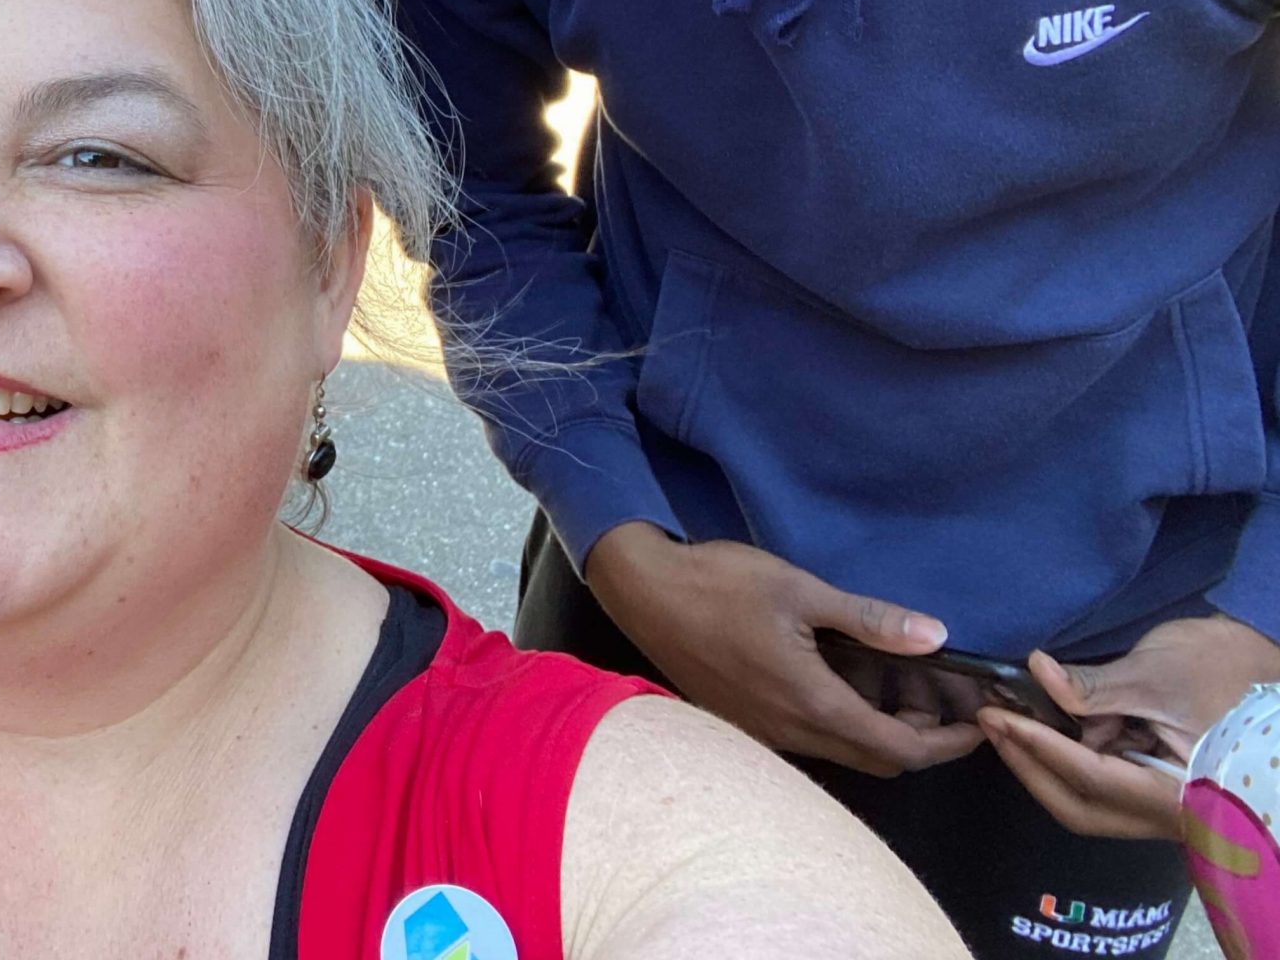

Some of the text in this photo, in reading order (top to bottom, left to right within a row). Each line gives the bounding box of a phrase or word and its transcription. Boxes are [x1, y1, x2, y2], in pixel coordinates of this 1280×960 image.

[1038, 4, 1115, 47] NIKE
[1090, 900, 1173, 930] MIAMI
[1011, 916, 1174, 956] SPORTSFEST
